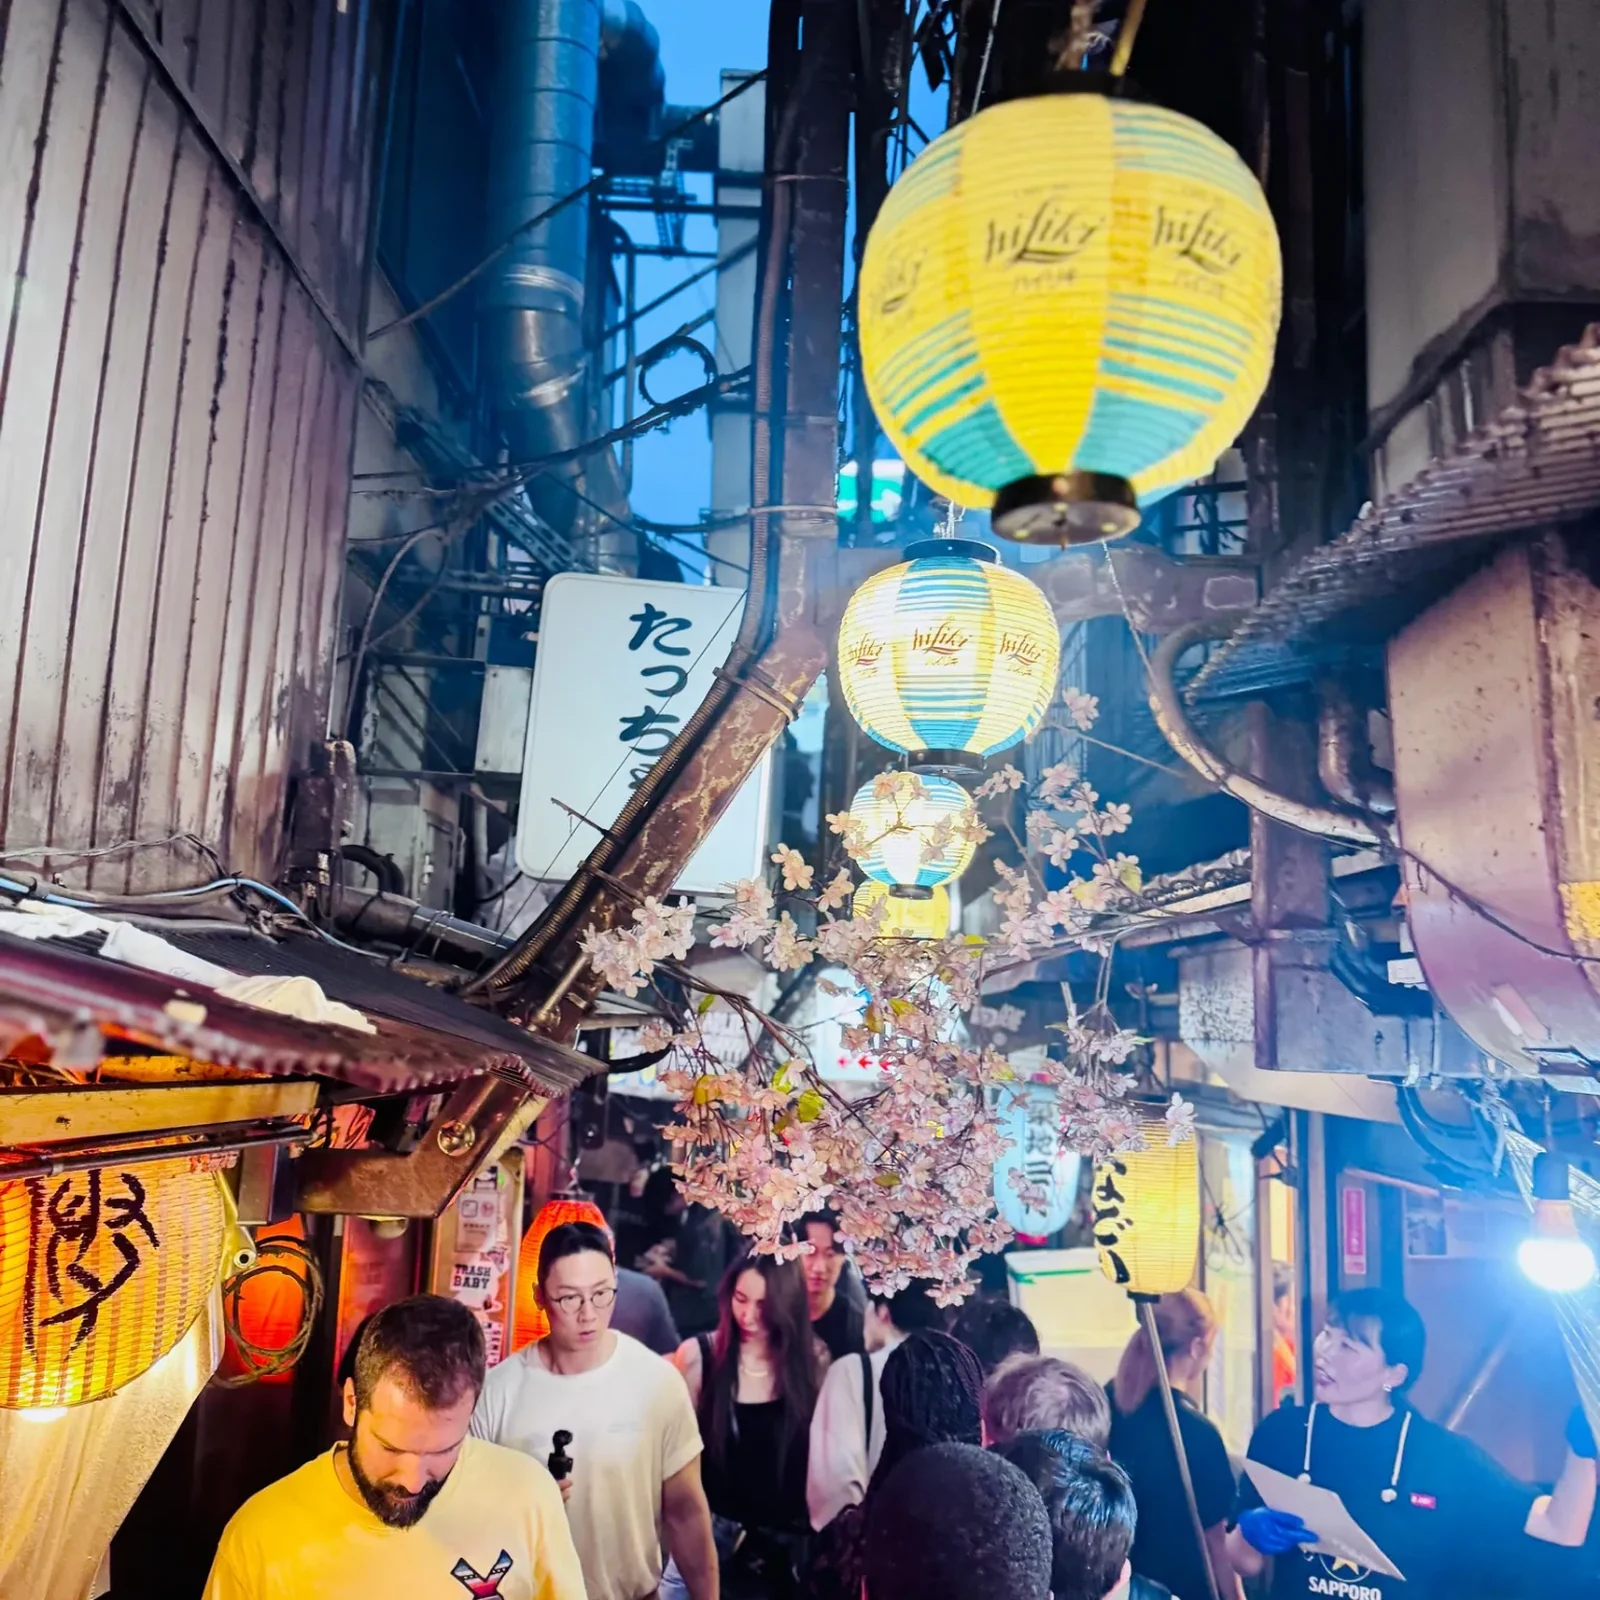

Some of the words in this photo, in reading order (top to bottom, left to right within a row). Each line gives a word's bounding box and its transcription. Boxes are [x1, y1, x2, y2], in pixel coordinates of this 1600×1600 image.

[453, 1263, 492, 1277] TRASH
[452, 1274, 491, 1290] BABY
[1308, 1576, 1383, 1600] SAPPORO
